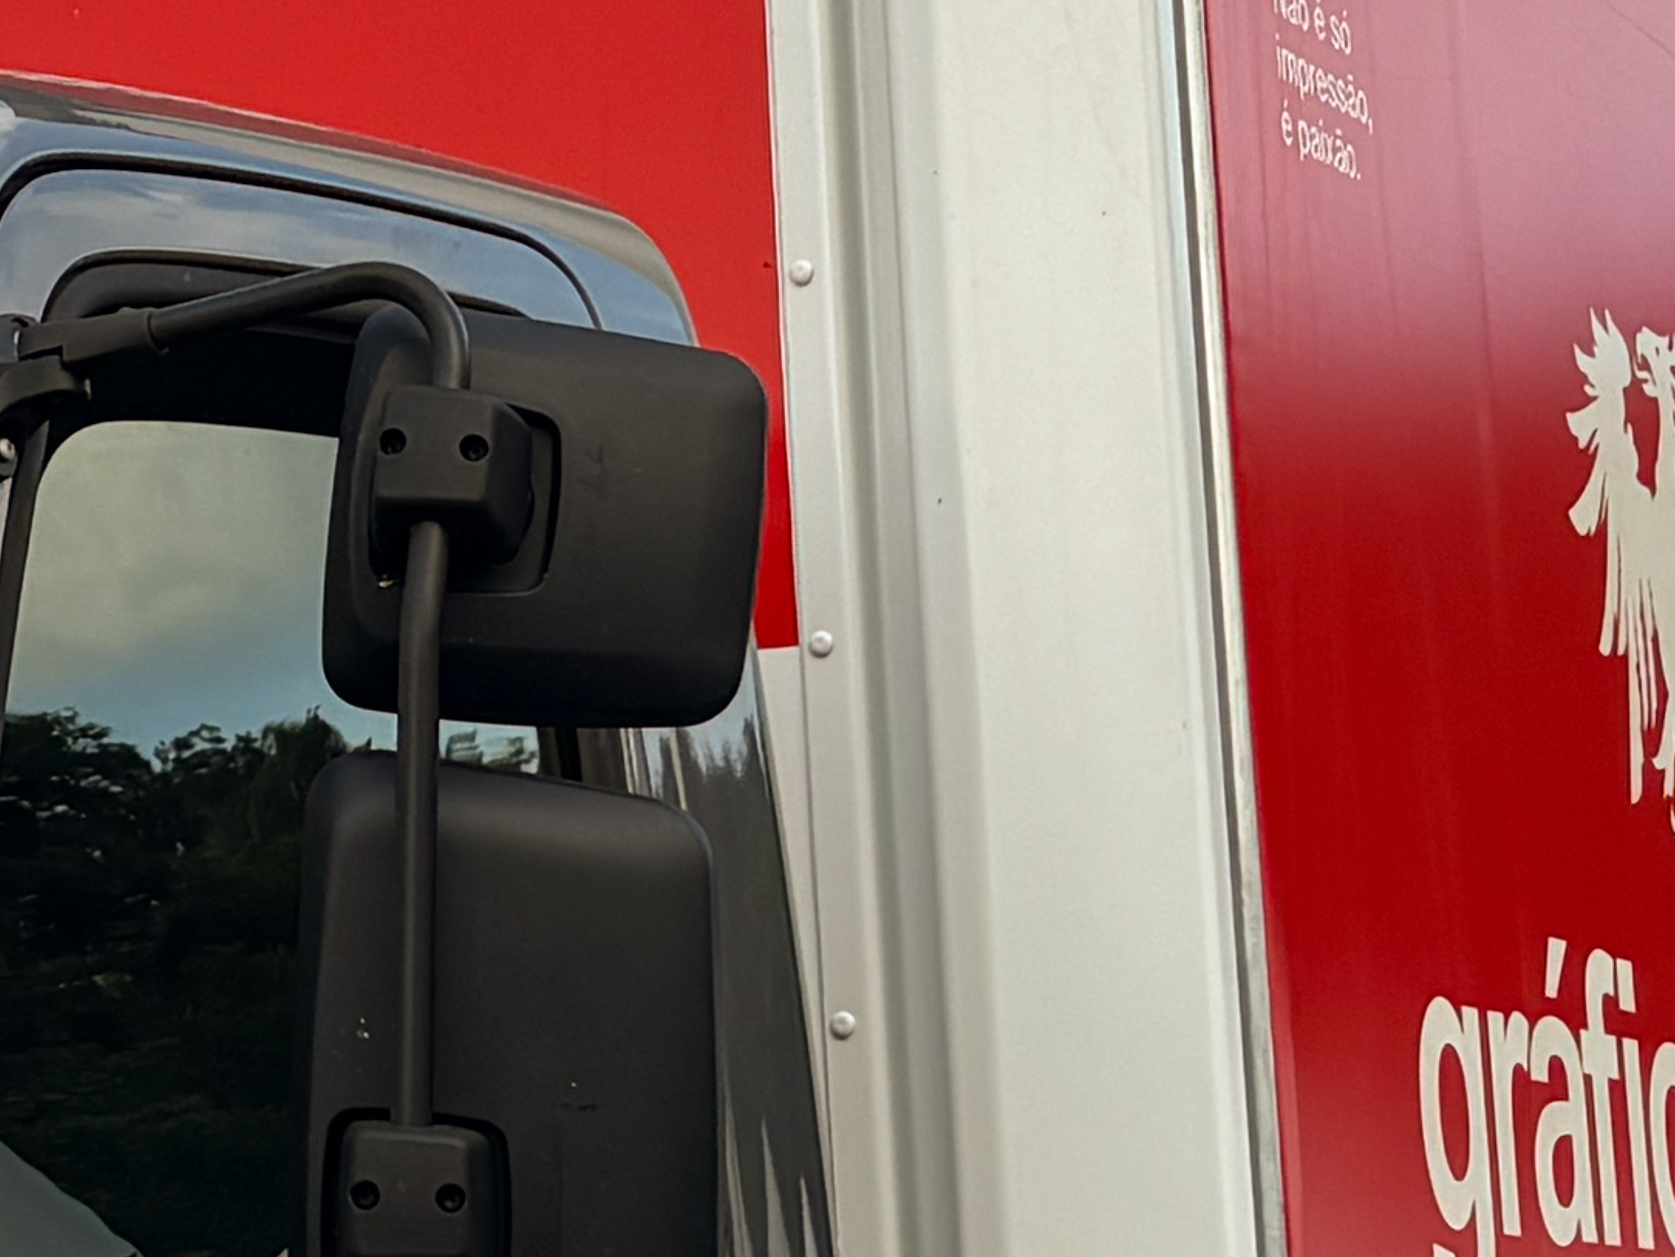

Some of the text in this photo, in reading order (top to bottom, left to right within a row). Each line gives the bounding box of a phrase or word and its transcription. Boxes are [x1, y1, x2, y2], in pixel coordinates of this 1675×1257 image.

[1329, 9, 1352, 56] só
[1275, 32, 1374, 136] impressão,
[1281, 98, 1362, 181] é paixão.
